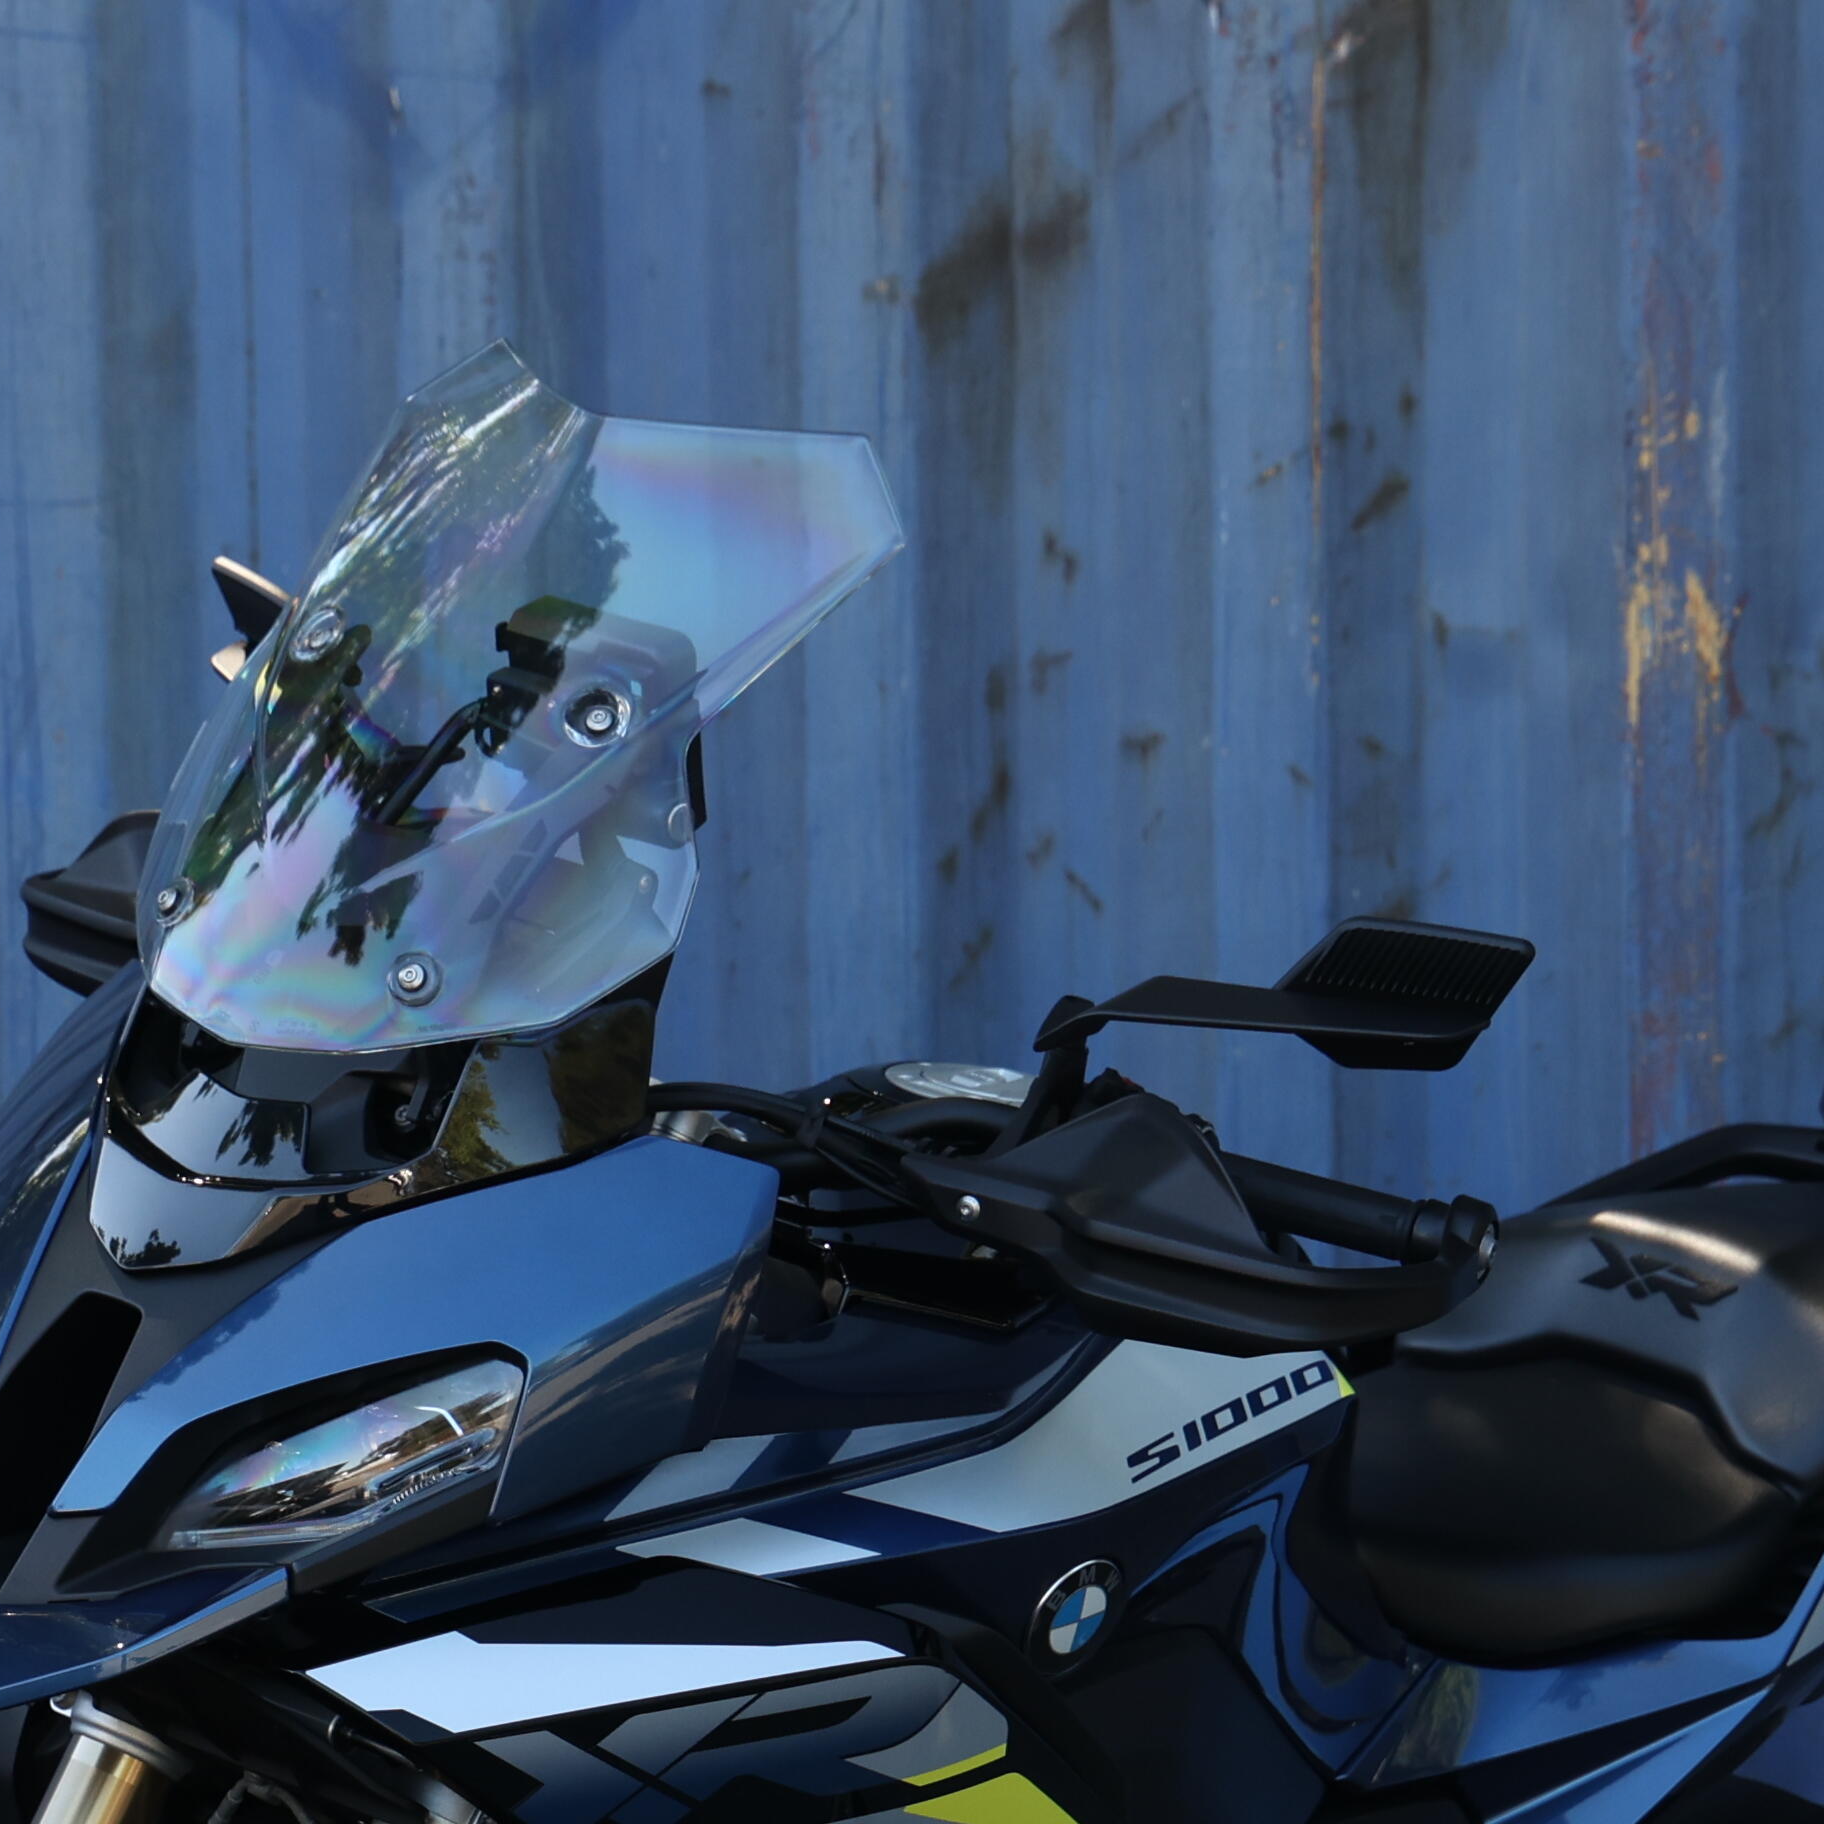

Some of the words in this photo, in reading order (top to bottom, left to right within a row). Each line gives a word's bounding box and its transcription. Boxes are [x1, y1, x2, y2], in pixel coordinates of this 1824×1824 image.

[1579, 1237, 1738, 1321] XR
[1127, 1360, 1334, 1483] S1000
[1046, 1564, 1121, 1611] BMW
